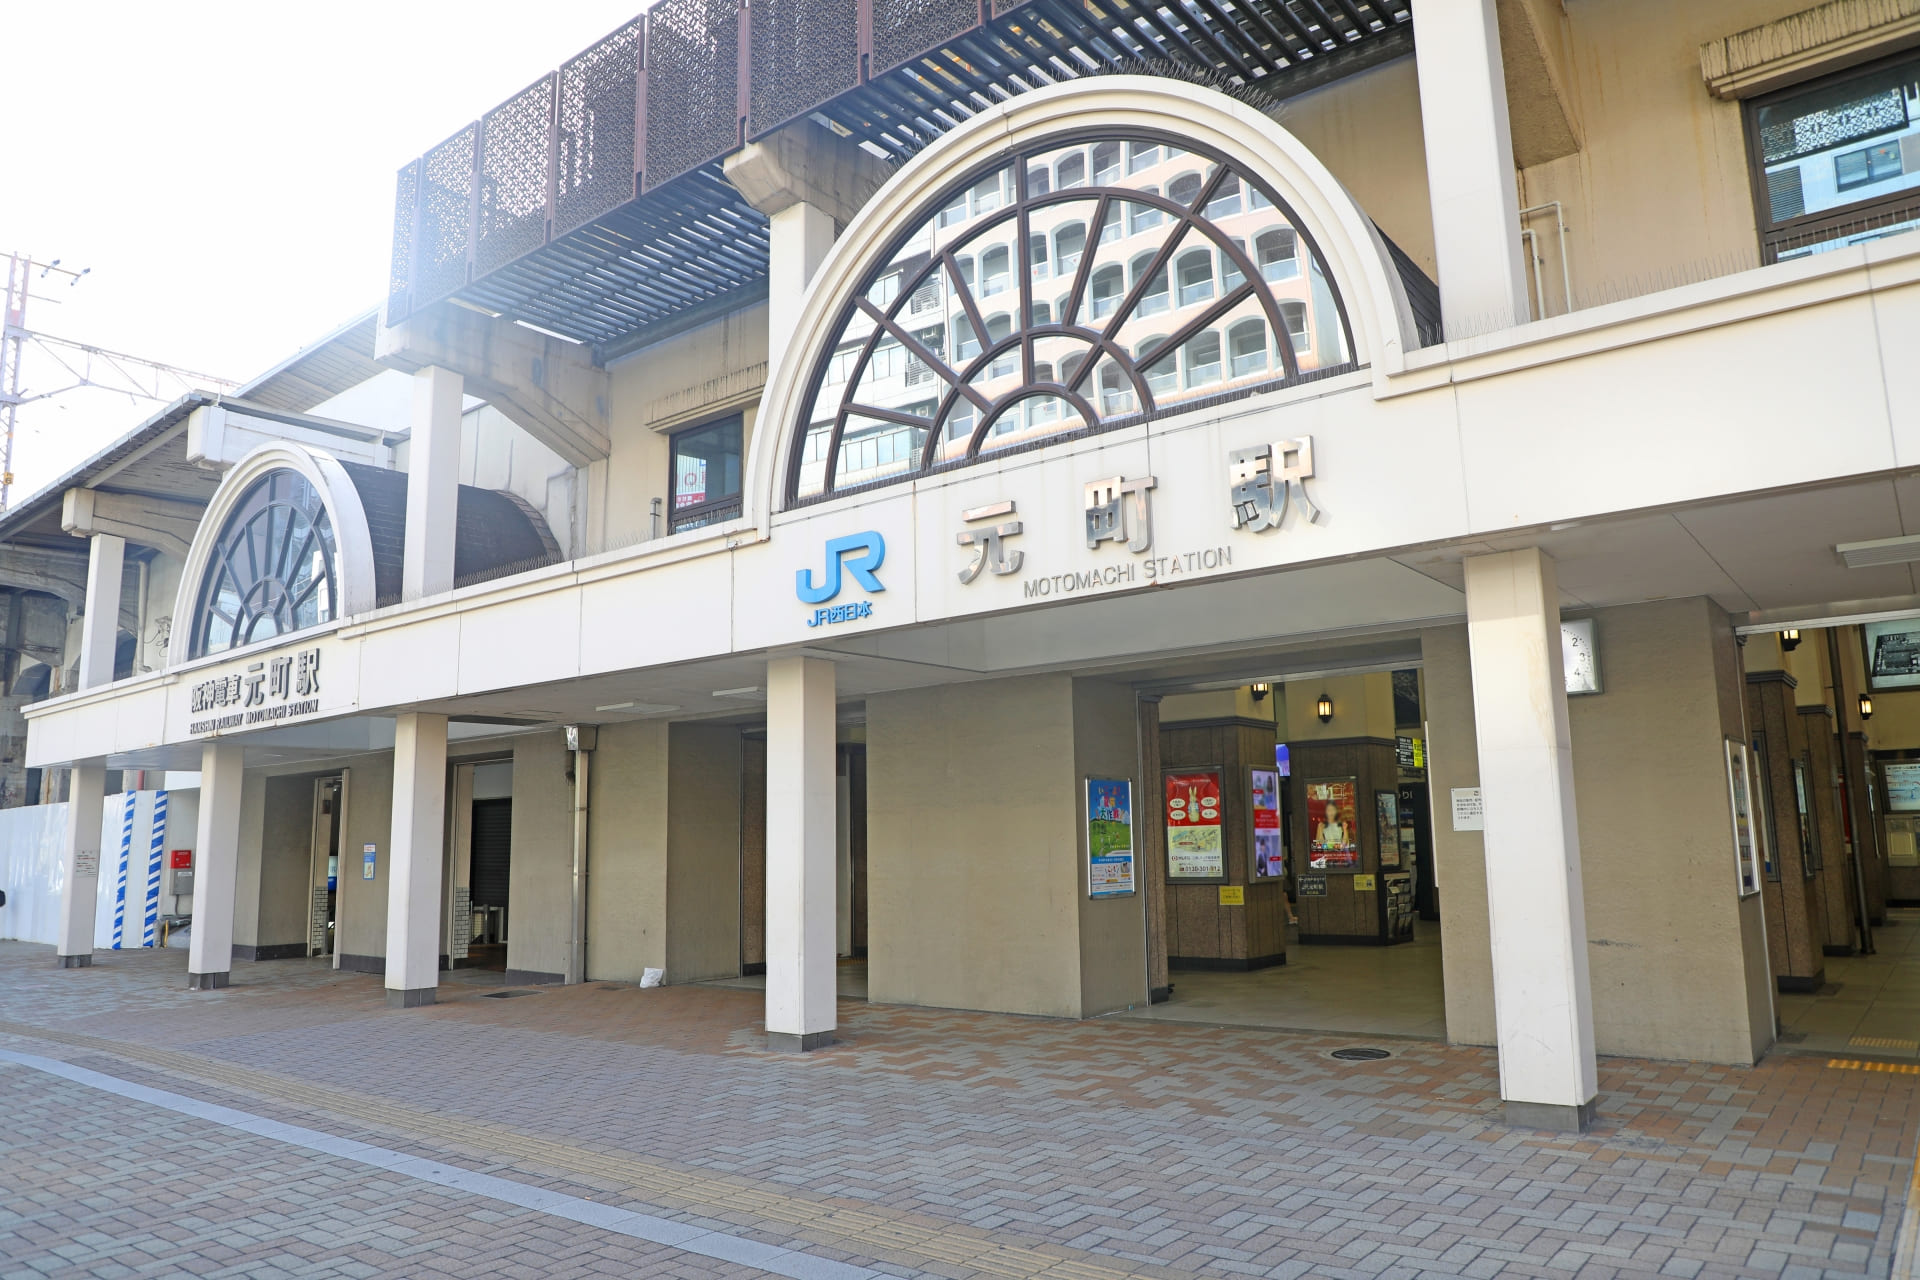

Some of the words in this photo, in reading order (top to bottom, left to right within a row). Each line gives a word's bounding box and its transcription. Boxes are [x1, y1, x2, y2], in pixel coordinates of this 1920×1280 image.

[957, 435, 1321, 585] 元町駅
[796, 530, 886, 603] JR
[1023, 562, 1135, 599] MOTOMACHI
[1143, 546, 1232, 579] STATION
[807, 600, 873, 628] JR西日本
[1572, 637, 1579, 647] 2
[1579, 652, 1586, 662] 3
[244, 648, 320, 708] 元町駅
[190, 718, 216, 735] HANSHIN
[216, 712, 244, 730] RAILWAY
[245, 705, 287, 724] MOTOMACHI
[287, 699, 319, 717] STATION
